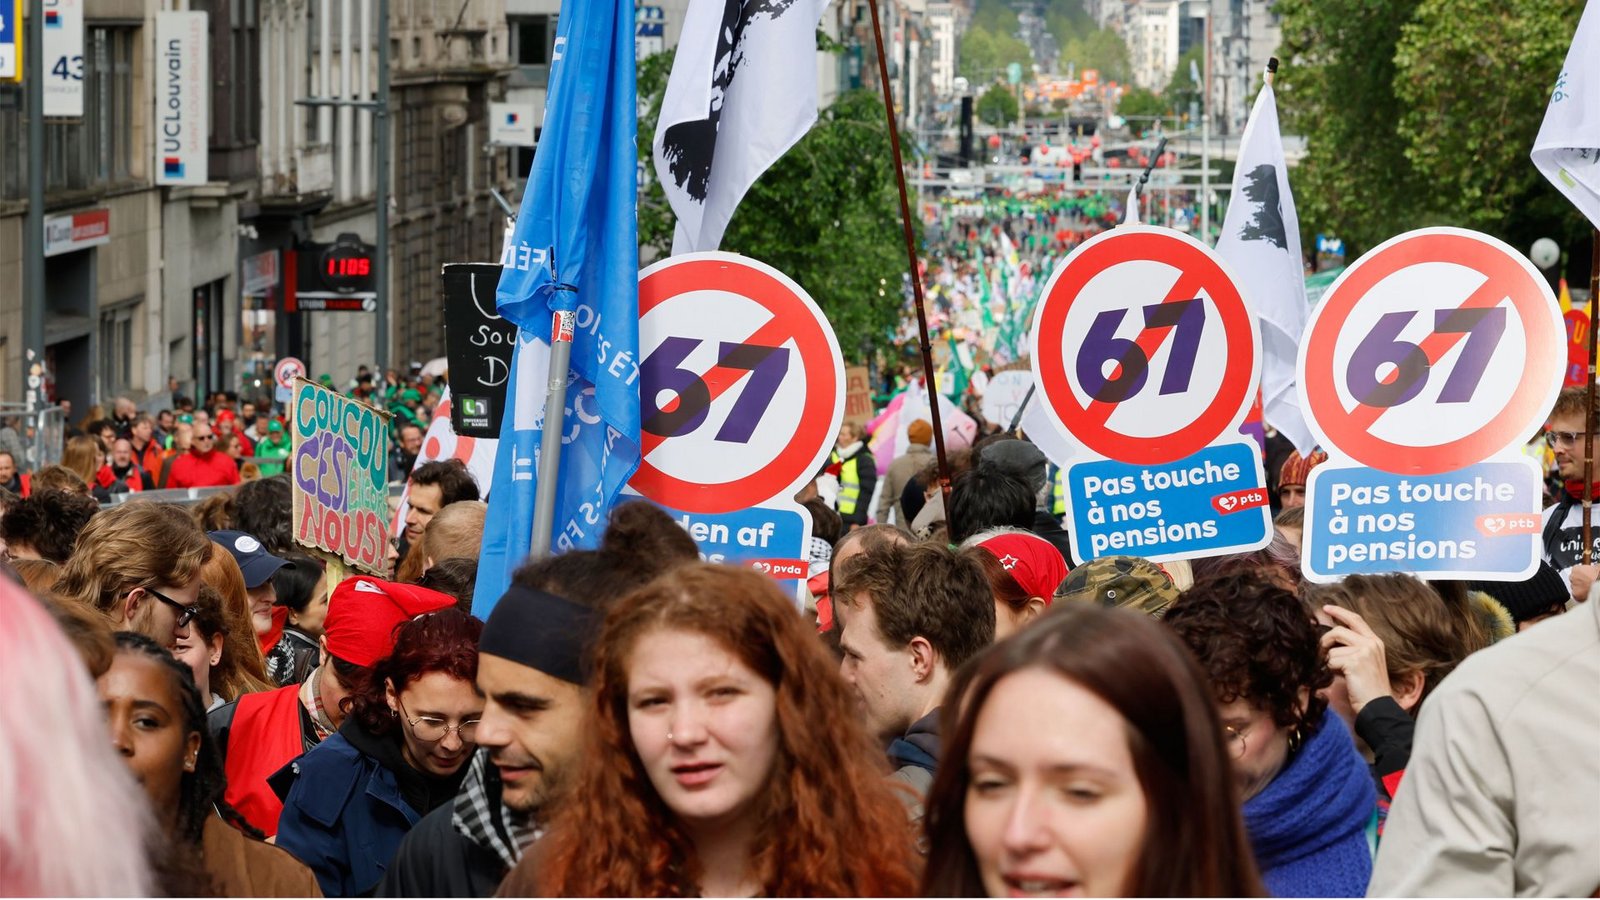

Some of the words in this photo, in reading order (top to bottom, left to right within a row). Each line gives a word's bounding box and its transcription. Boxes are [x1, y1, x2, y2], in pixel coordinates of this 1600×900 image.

[164, 38, 181, 152] UCLouvain
[1076, 298, 1206, 403] 67
[1346, 307, 1507, 408] 67
[639, 336, 791, 444] 67
[296, 384, 389, 492] COUCOU
[295, 430, 354, 514] C'EST
[1083, 475, 1136, 499] Pas
[1141, 460, 1240, 491] touche
[1331, 483, 1390, 507] Pas
[1398, 476, 1515, 503] touche
[1087, 500, 1106, 525] à
[1111, 499, 1162, 523] nos
[1240, 493, 1262, 506] ptb
[1328, 509, 1349, 534] à
[1357, 512, 1415, 534] nos
[1509, 518, 1535, 530] ptb
[300, 493, 388, 570] NOUS!
[736, 522, 775, 548] af
[1091, 518, 1218, 557] pensions
[773, 564, 802, 575] pvda
[1327, 533, 1477, 570] pensions
